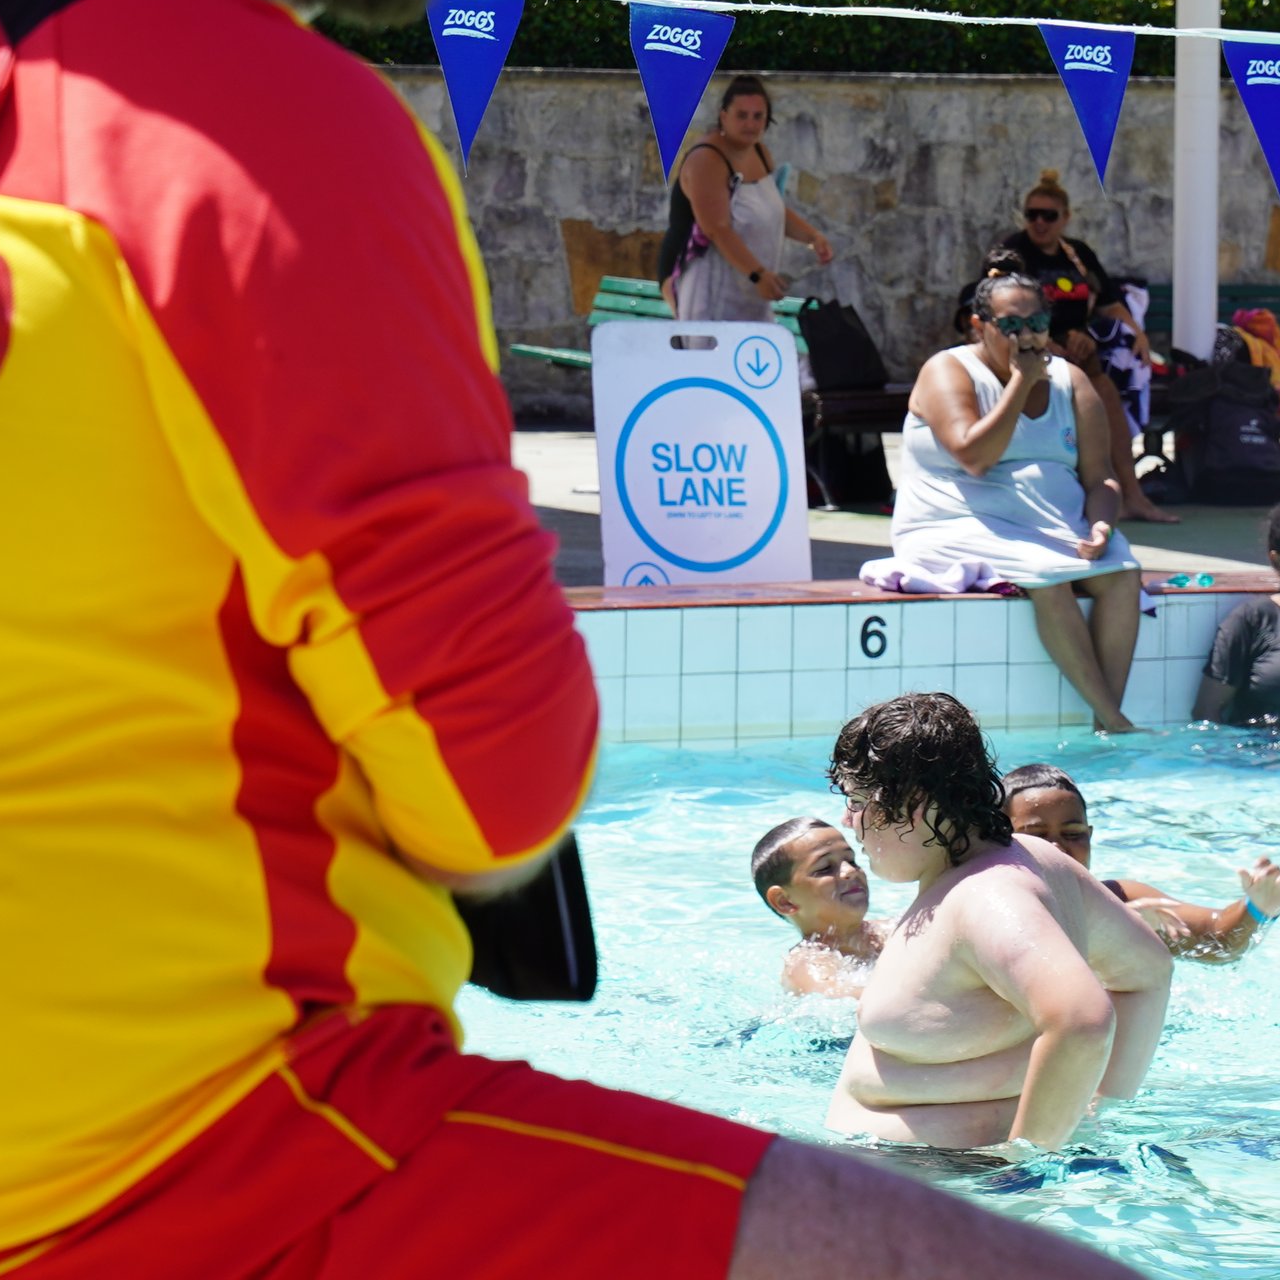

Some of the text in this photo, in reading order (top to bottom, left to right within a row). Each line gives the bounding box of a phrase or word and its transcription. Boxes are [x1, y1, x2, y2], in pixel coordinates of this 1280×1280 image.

[444, 9, 495, 32] ZOGGS
[647, 25, 702, 50] ZOGGS
[1065, 45, 1111, 65] ZOGGS
[651, 442, 748, 473] SLOW
[658, 478, 747, 506] LANE
[860, 615, 887, 659] 6
